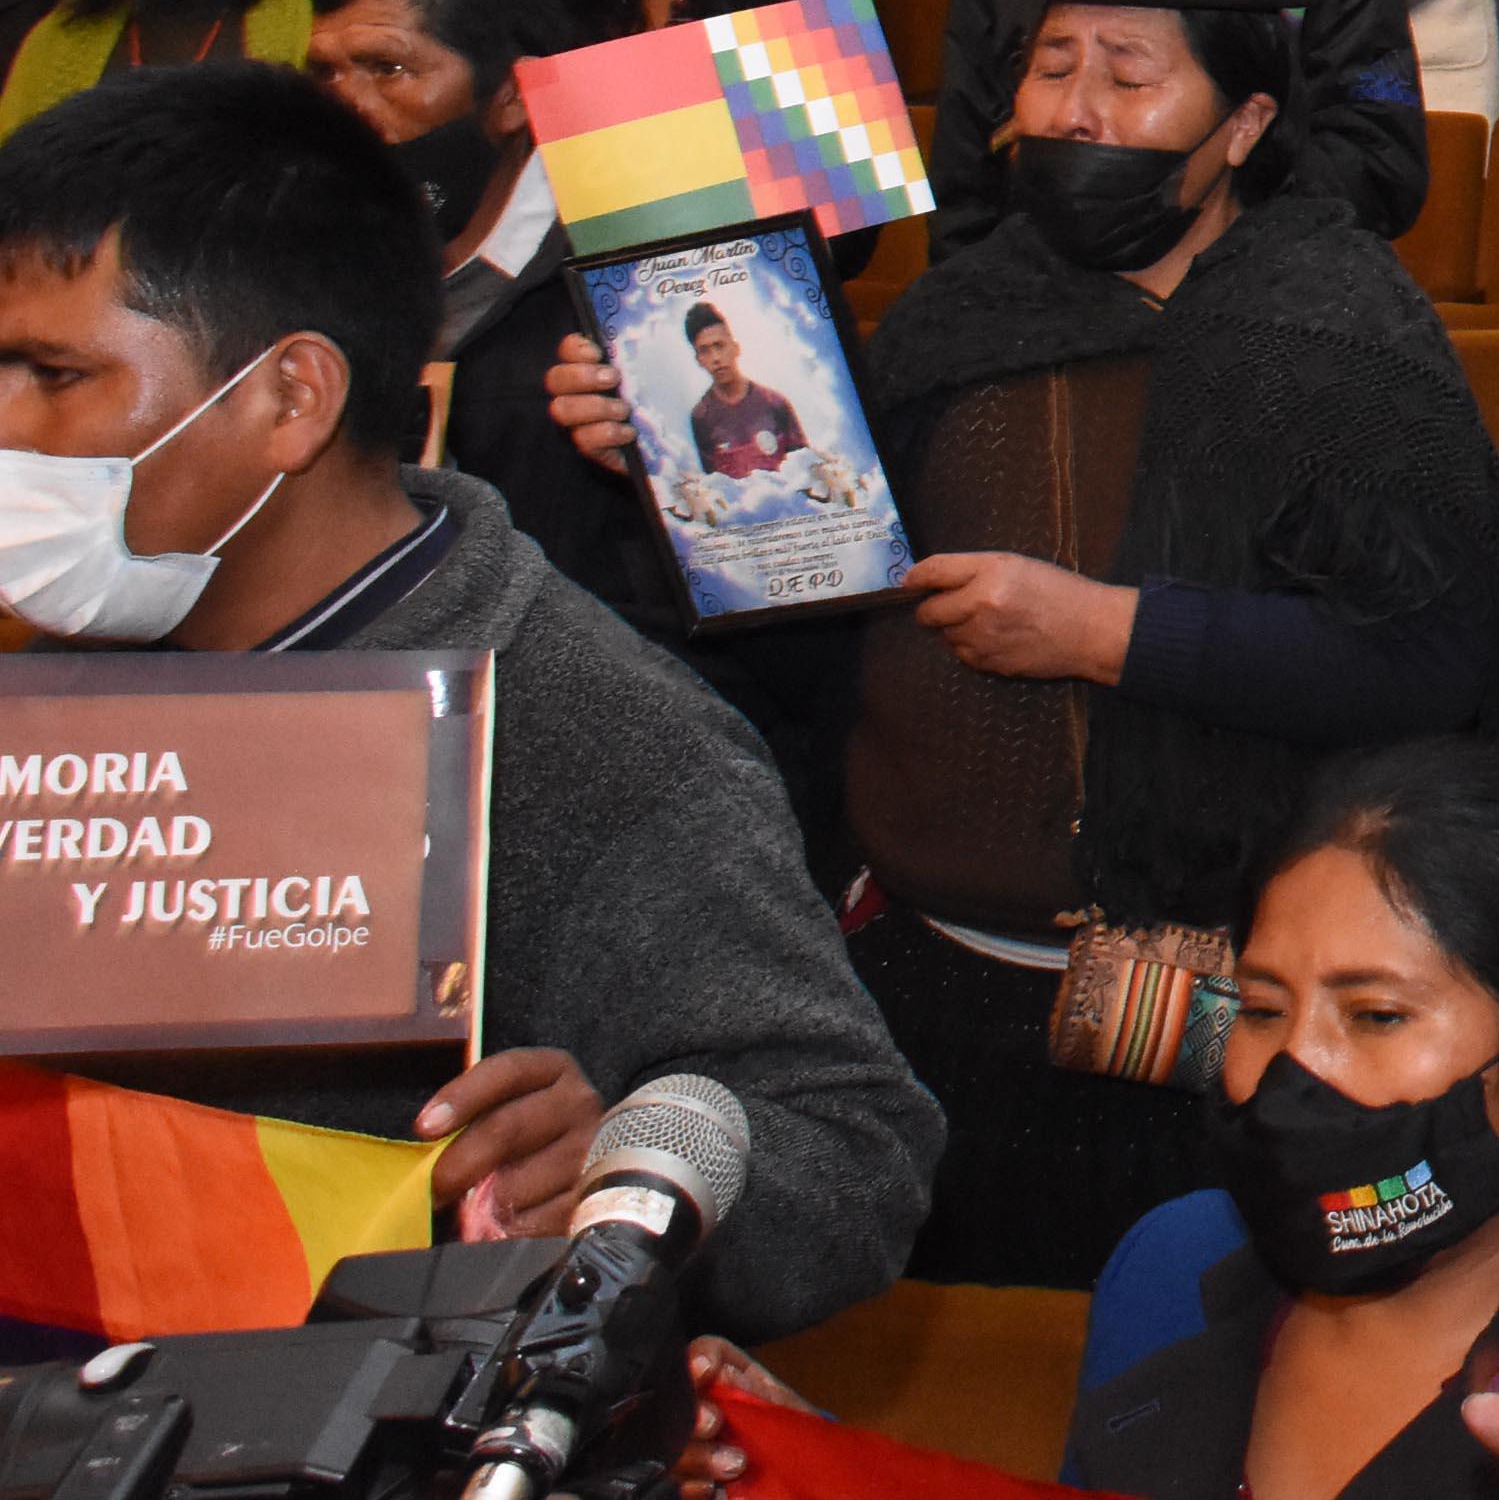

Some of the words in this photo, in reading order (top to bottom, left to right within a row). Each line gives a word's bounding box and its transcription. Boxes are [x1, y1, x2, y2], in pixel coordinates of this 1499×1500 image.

[639, 257, 689, 282] Juan
[0, 815, 211, 862] ERDAD
[73, 882, 108, 924] Y
[121, 875, 371, 923] JUSTICIA
[208, 922, 369, 953] #FueGolpe
[1326, 1181, 1448, 1234] SHINAHOTA
